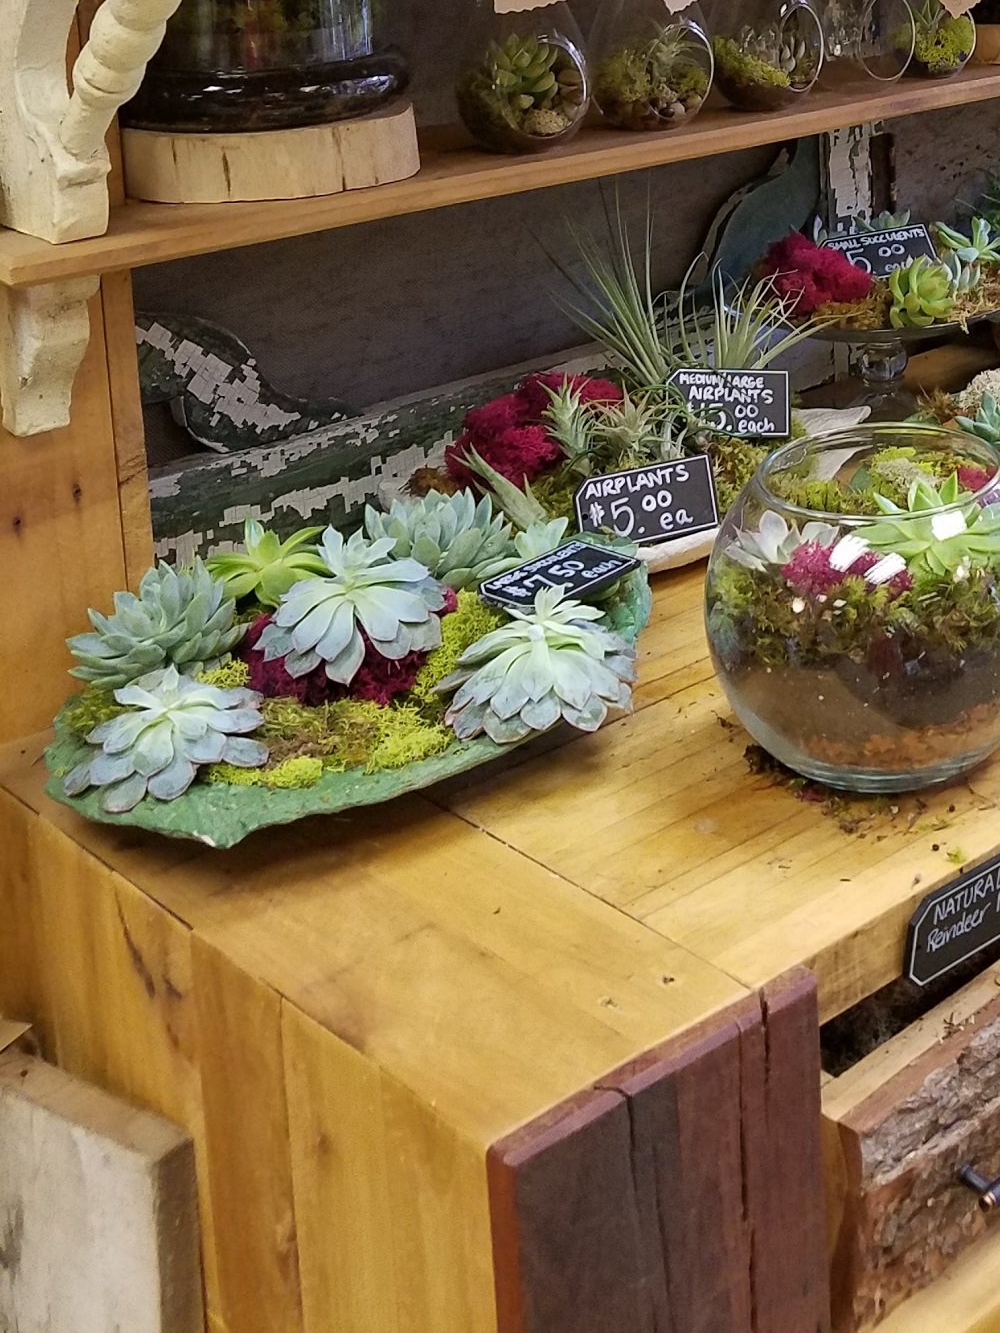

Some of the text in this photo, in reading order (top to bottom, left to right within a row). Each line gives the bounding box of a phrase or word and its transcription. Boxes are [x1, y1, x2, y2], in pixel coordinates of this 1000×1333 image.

[827, 228, 925, 251] SMALL SUCCULENTS
[688, 385, 774, 405] AIRPLANTS
[737, 417, 775, 434] each
[584, 464, 690, 500] AIRPLANTS
[659, 508, 694, 531] ea
[581, 558, 623, 579] each
[926, 902, 992, 953] Reindeer
